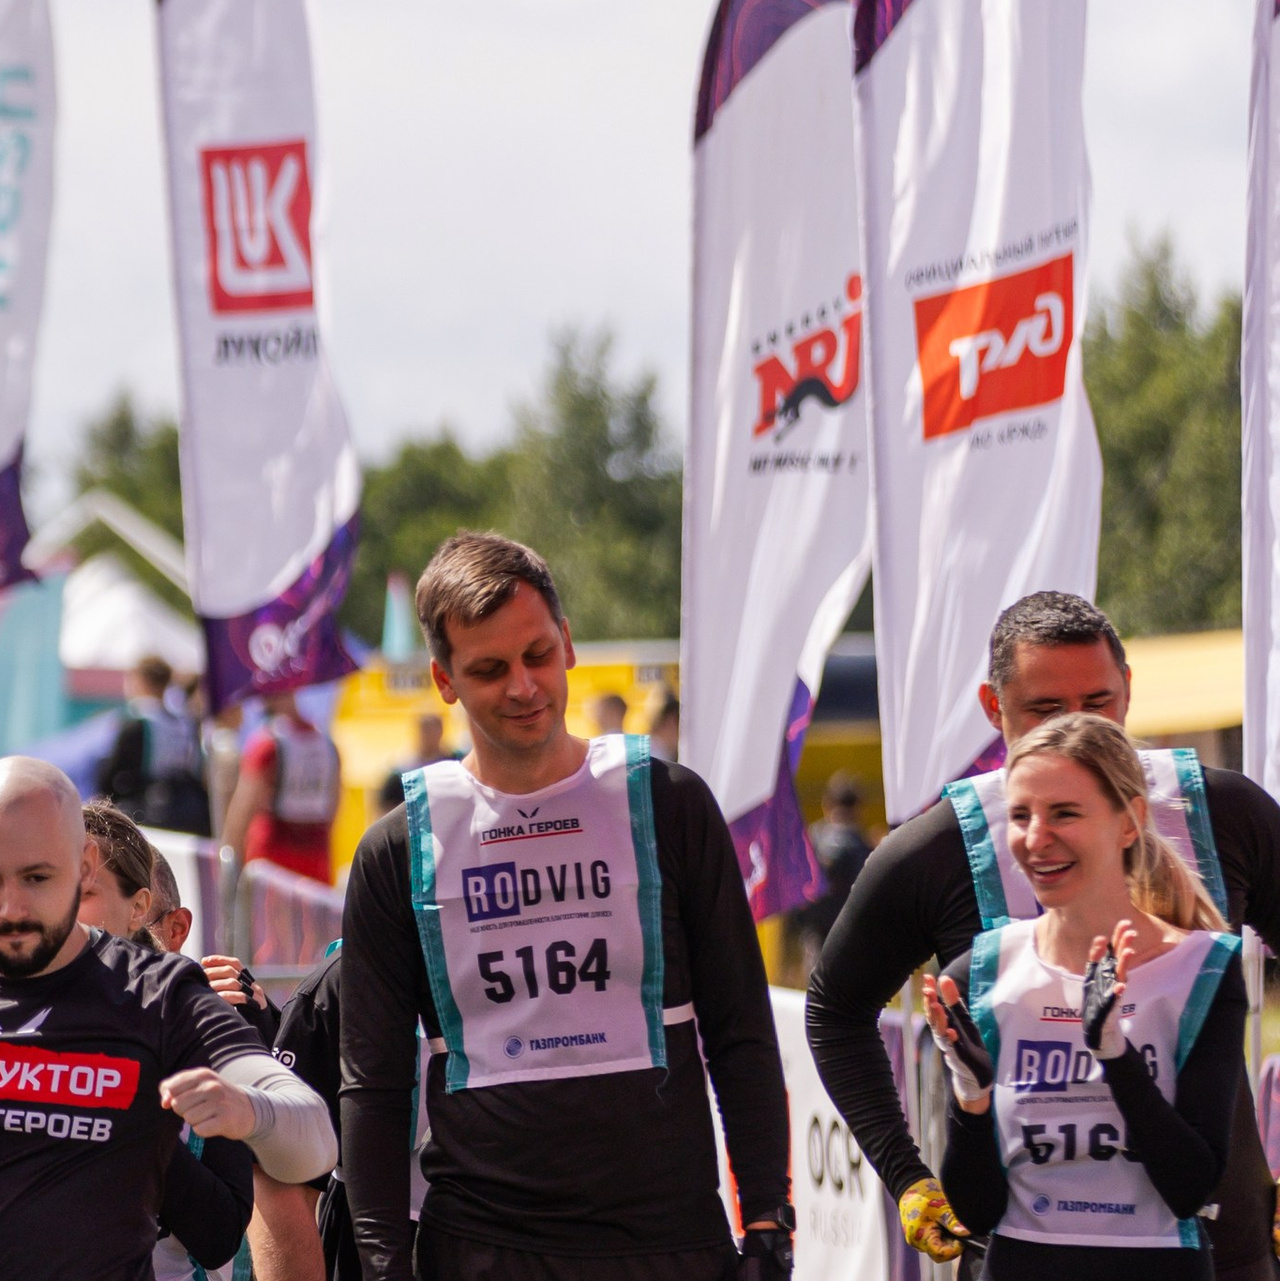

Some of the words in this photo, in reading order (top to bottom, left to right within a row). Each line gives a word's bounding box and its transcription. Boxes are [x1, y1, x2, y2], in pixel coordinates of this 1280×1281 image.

[482, 825, 525, 841] ГОНКА
[529, 818, 580, 834] ГЕРОЕВ
[467, 860, 611, 915] RODVIG
[477, 938, 611, 1004] 5164
[1043, 1006, 1082, 1018] ГОНК
[529, 1032, 607, 1051] ГАЗПРОМБАНК
[1021, 1123, 1141, 1165] 516
[1057, 1200, 1136, 1215] ГАЗПРОМБАНК
